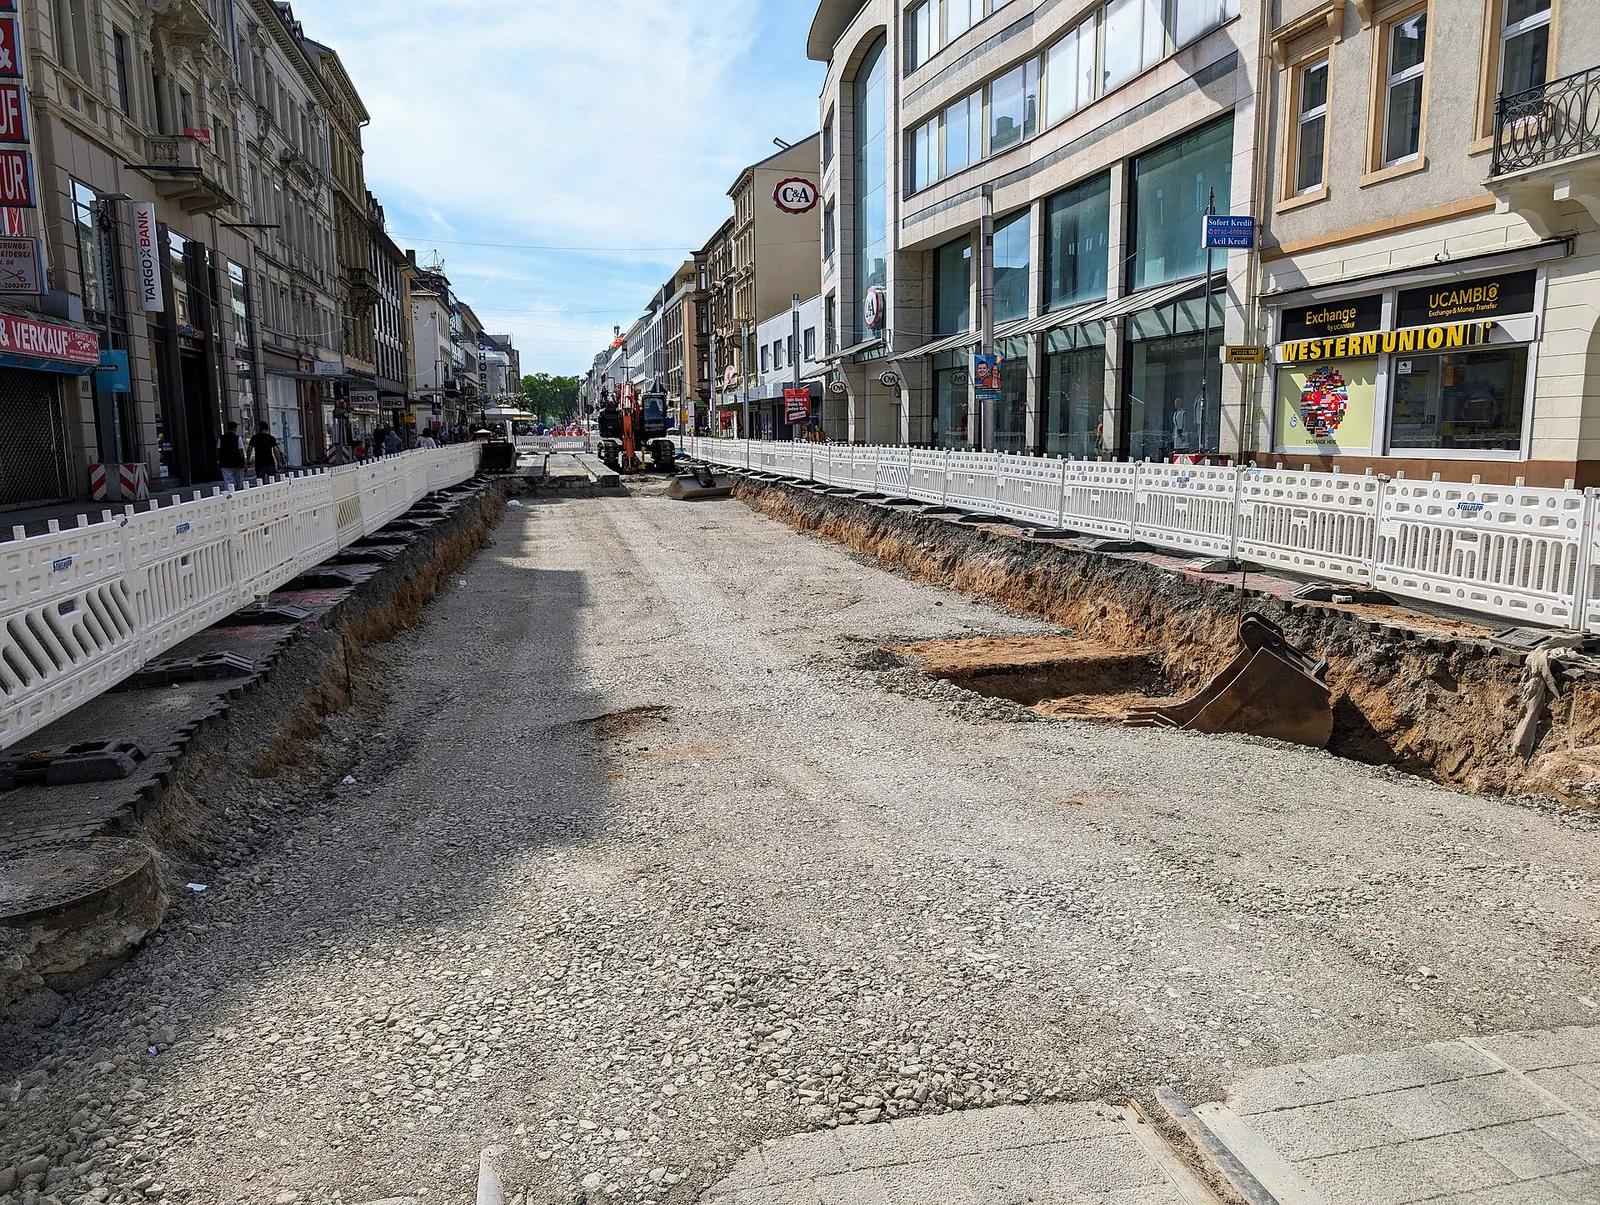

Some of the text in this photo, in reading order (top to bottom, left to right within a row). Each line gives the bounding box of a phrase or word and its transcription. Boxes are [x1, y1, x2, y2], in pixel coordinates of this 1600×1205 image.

[0, 155, 27, 200] UR
[782, 187, 811, 203] C&A
[1208, 218, 1253, 227] Sofort Kredit
[1476, 302, 1498, 311] Transfer
[1305, 308, 1357, 325] Exchange
[11, 320, 69, 356] VERKAUF
[1282, 323, 1465, 362] WESTERN UNION
